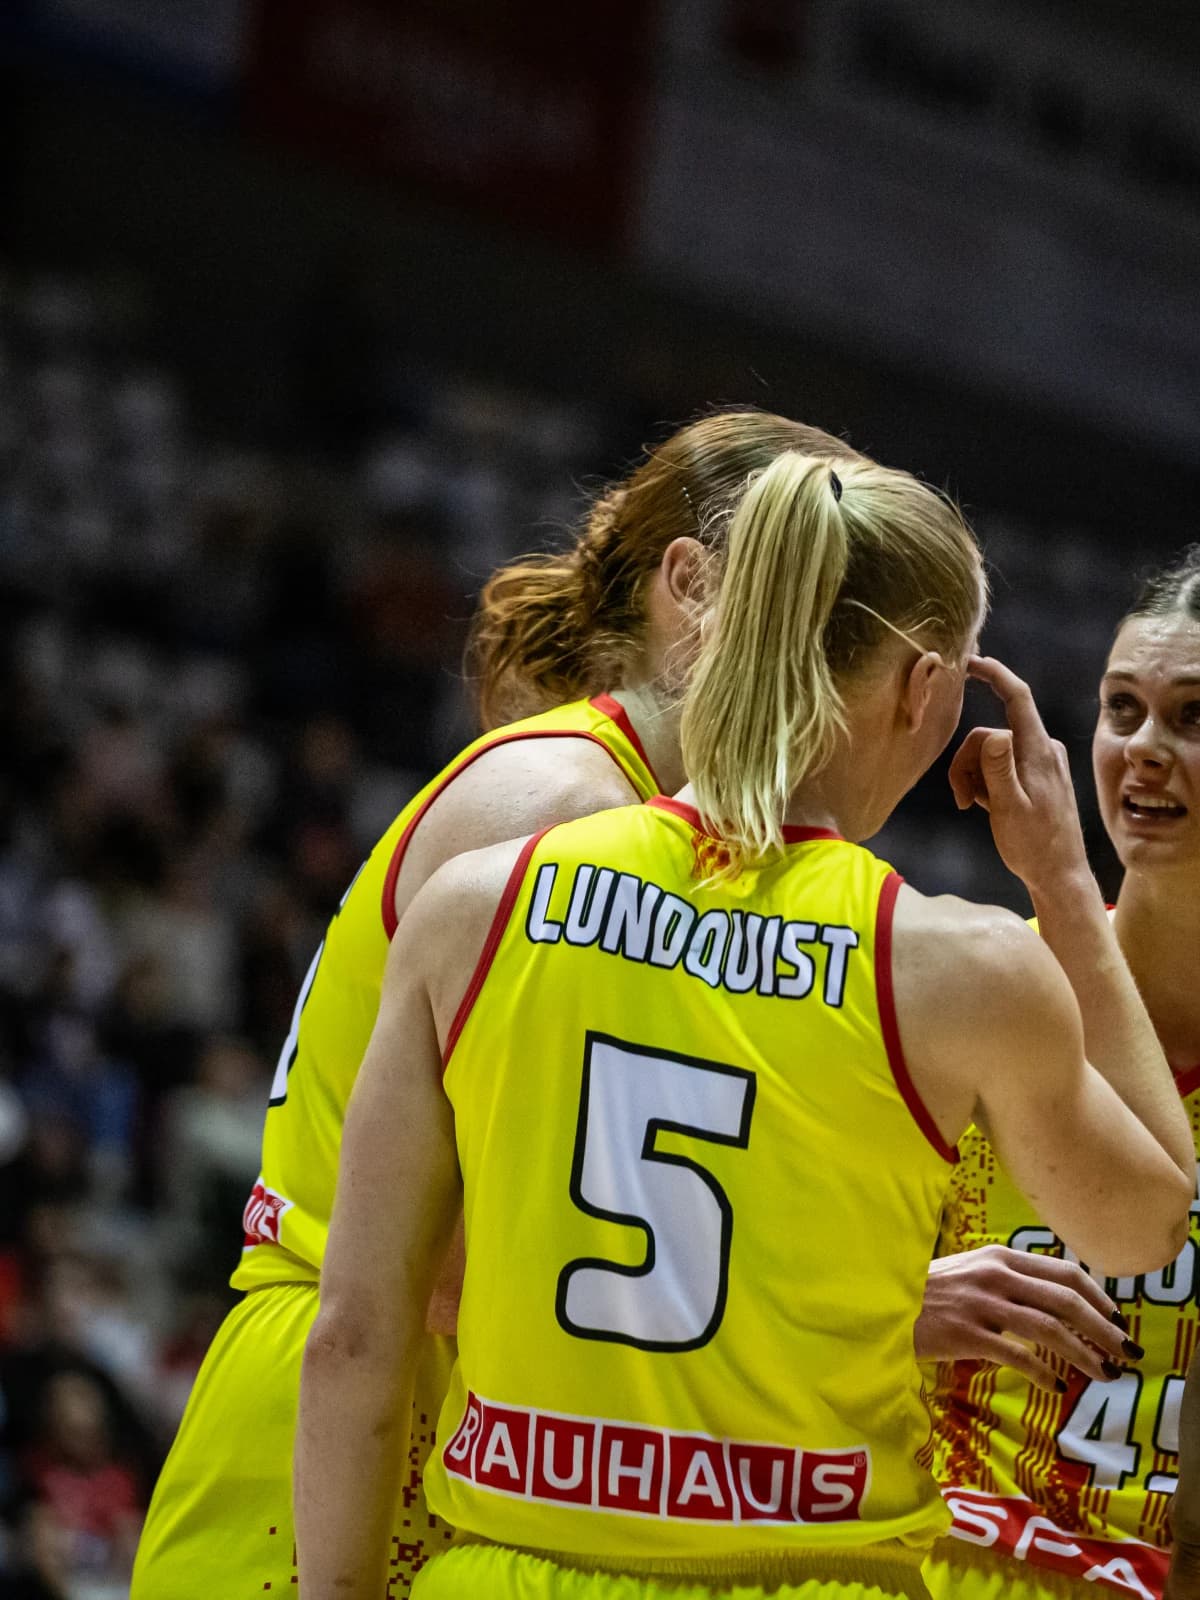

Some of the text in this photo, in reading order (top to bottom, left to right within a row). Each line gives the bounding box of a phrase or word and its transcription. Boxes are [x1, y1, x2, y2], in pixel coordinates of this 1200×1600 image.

[525, 862, 860, 1009] LUNDQUIST
[555, 1029, 757, 1353] 5
[448, 1405, 857, 1515] BAUHAUS
[946, 1497, 1158, 1600] SPA
